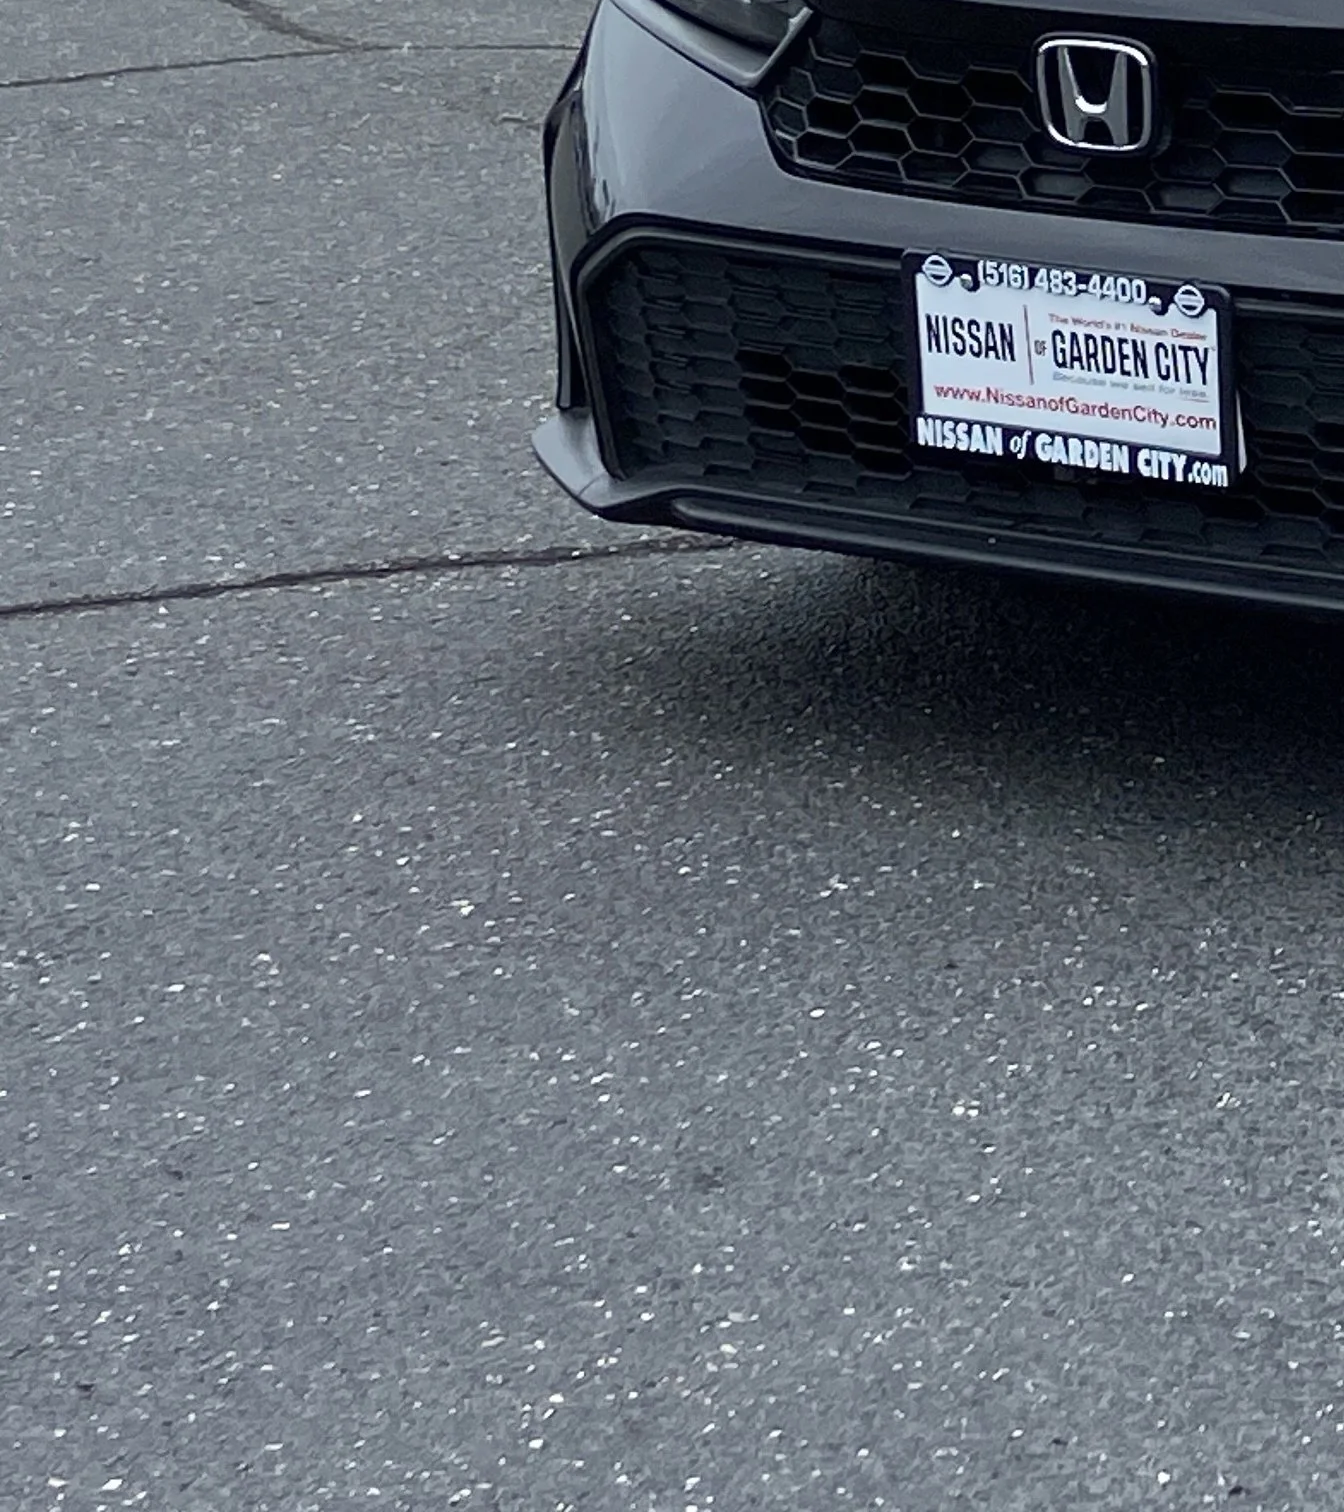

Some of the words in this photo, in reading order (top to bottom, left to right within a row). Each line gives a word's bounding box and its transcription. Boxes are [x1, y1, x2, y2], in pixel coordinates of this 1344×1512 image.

[978, 259, 1029, 289] (516)
[1034, 267, 1147, 305] 483-4400
[925, 313, 1016, 362] NISSAN
[1034, 339, 1047, 356] OF
[1052, 329, 1149, 379] GARDEN
[1155, 342, 1208, 385] CITY
[934, 385, 1217, 430] www.NissanofGardenCity.com
[917, 416, 1003, 456] NISSAN
[1009, 429, 1032, 460] of
[1035, 433, 1130, 474] GARDEN
[1136, 448, 1229, 487] CITY.com
